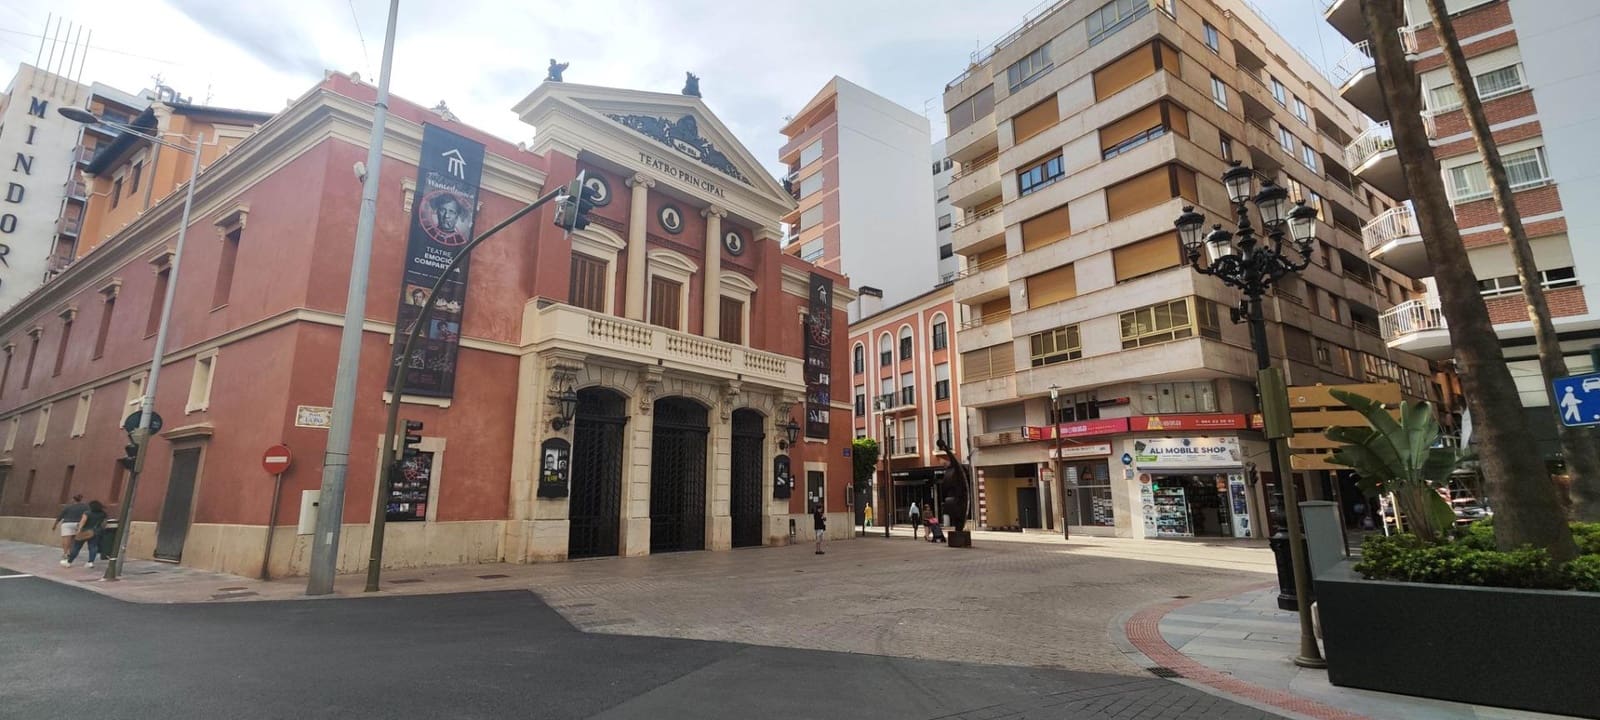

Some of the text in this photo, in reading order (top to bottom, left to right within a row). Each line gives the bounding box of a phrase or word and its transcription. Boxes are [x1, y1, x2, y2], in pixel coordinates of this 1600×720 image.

[639, 152, 678, 176] TEATRO
[0, 96, 48, 289] MINDOR
[1166, 446, 1198, 454] MOBILE
